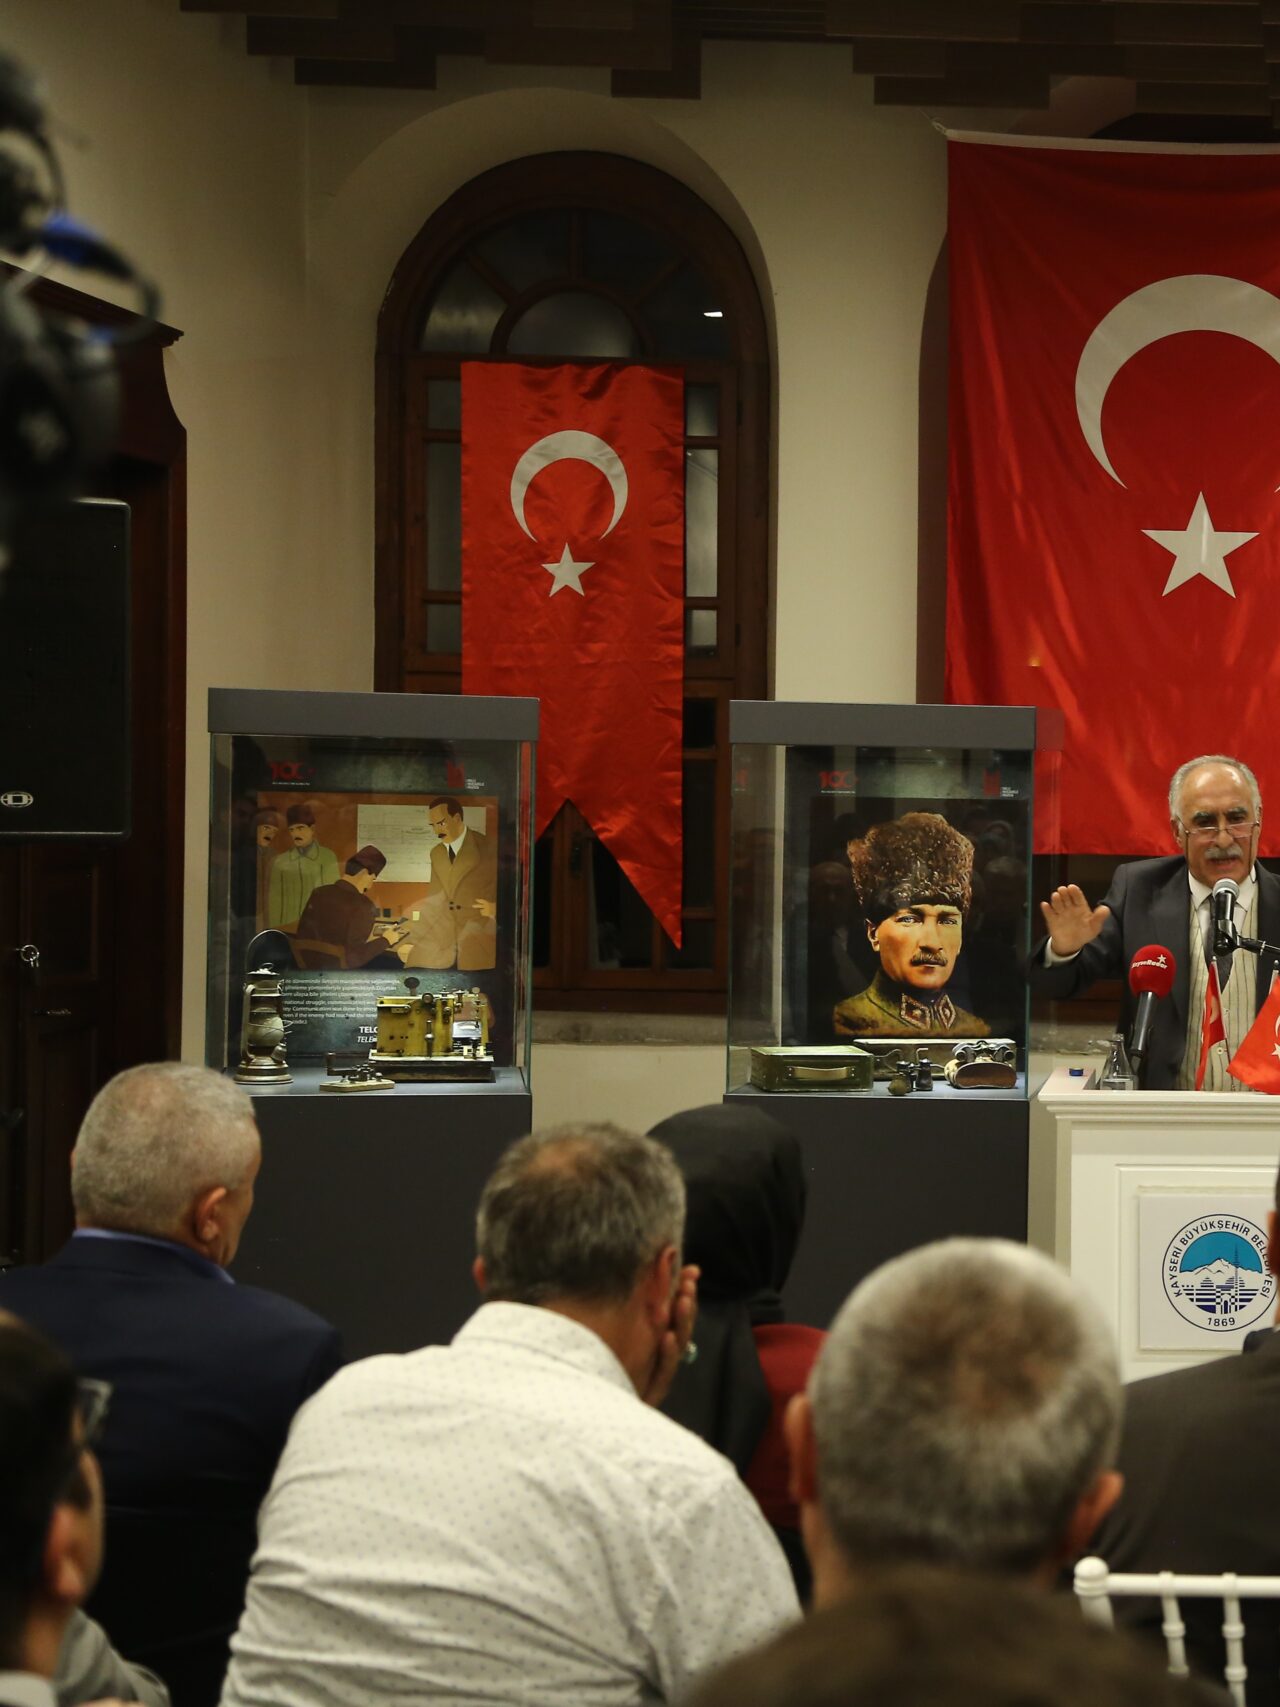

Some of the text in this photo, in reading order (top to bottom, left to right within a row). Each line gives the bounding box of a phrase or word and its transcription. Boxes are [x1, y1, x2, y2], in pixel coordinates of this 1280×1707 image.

[1169, 1247, 1183, 1298] KAYSERİ
[1180, 1219, 1250, 1246] BÜYÜKŞEHİR
[1207, 1317, 1236, 1327] 1869
